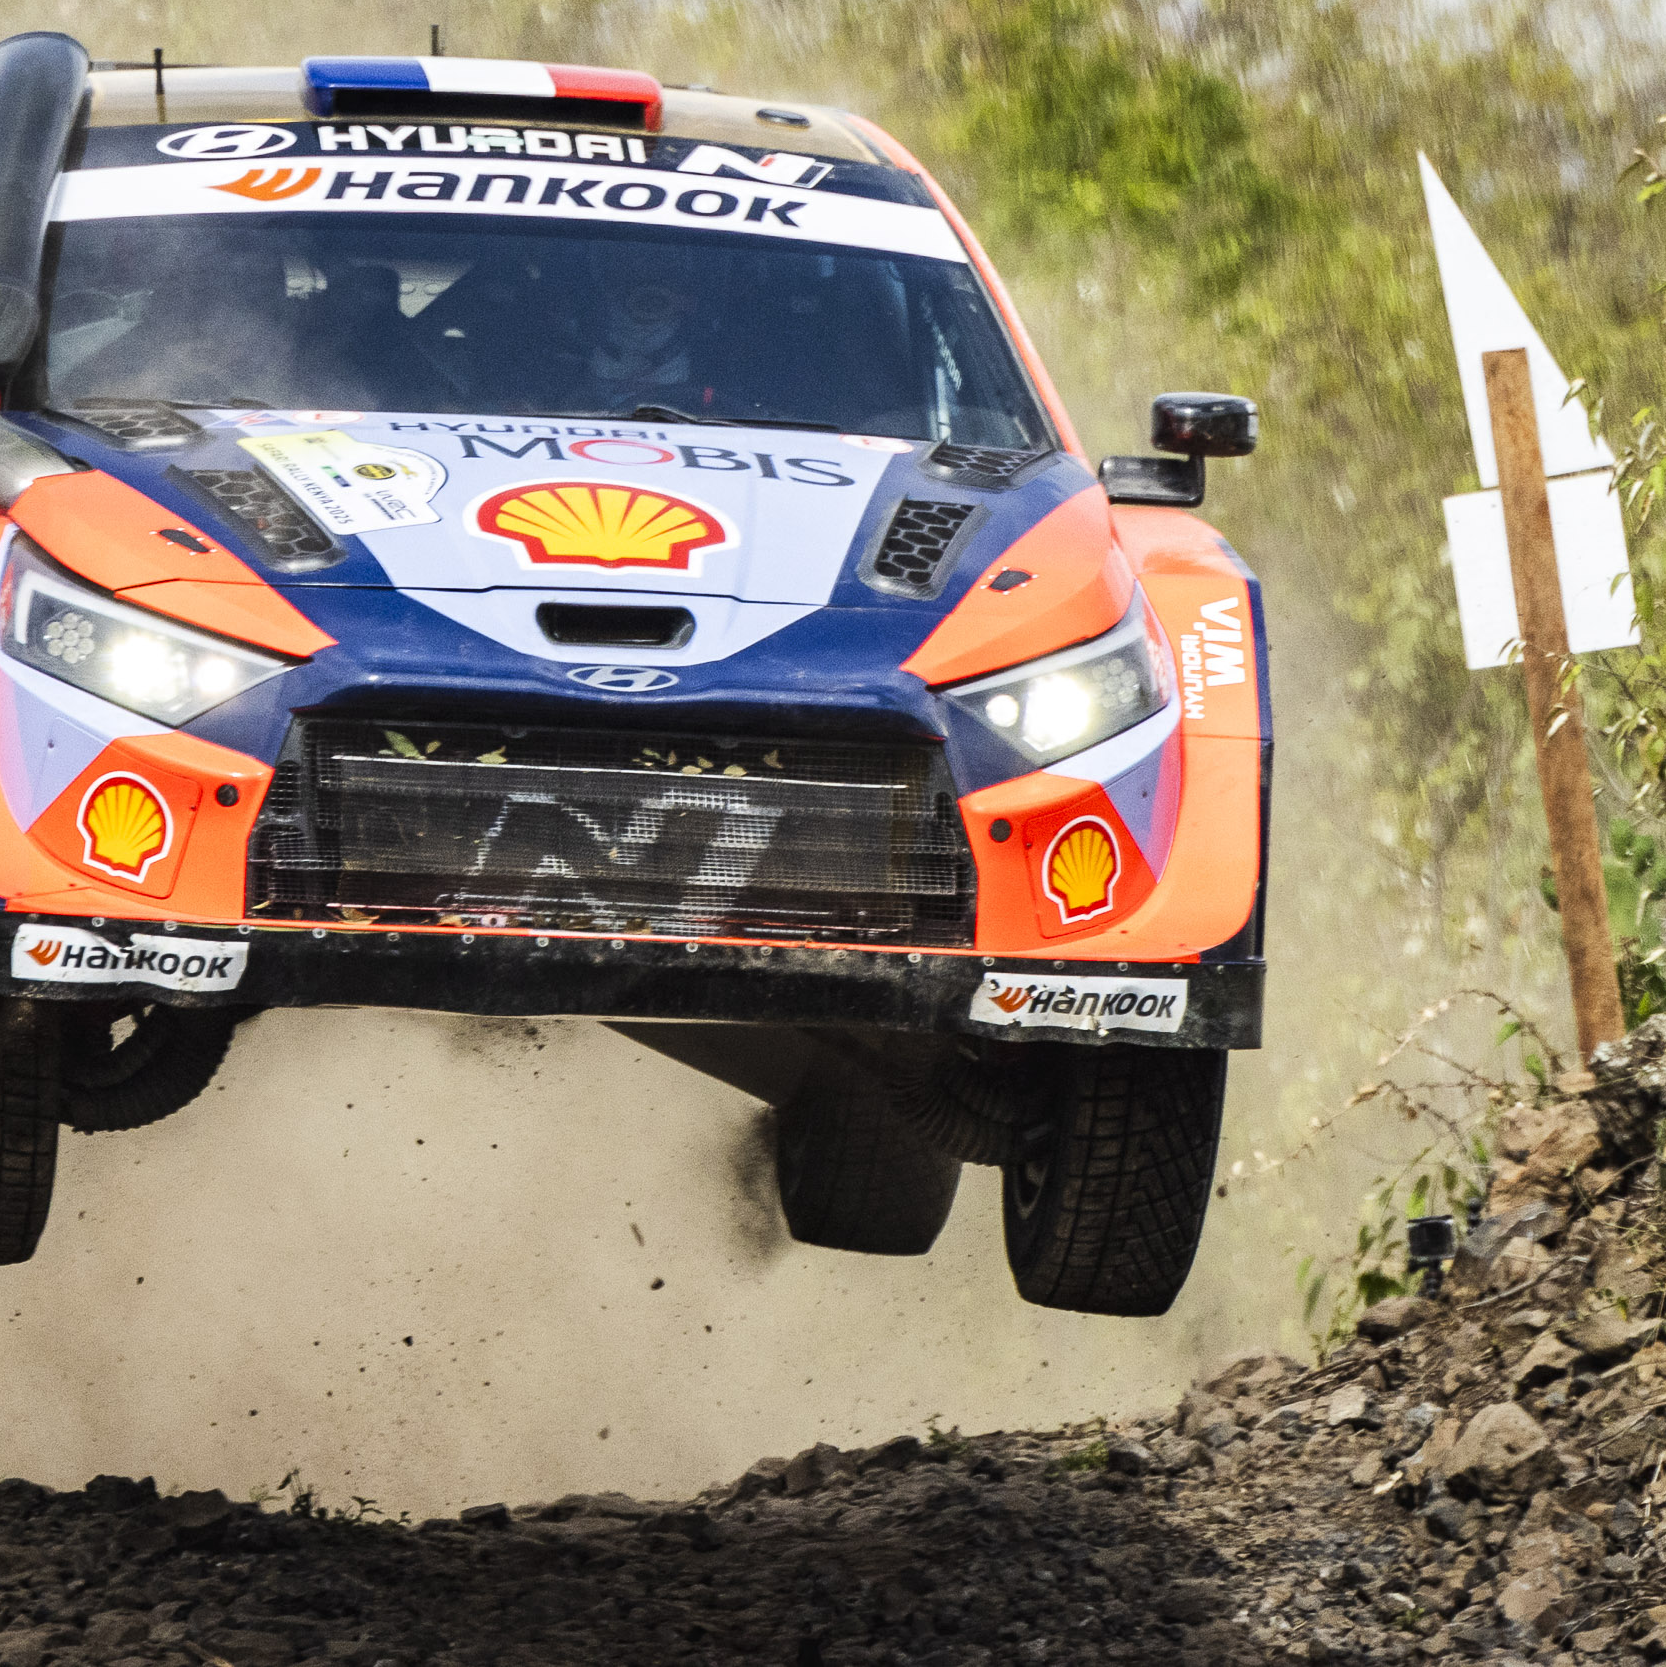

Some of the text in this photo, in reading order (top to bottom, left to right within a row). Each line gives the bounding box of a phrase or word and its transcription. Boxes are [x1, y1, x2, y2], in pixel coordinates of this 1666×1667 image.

[317, 125, 648, 163] HYUNDAI
[388, 421, 668, 441] HYUNDAI
[258, 442, 291, 462] SAFARI
[280, 462, 311, 480] RALLY
[300, 481, 336, 504] KENYA
[323, 504, 357, 524] 2025
[454, 434, 857, 487] MOBIS
[1180, 634, 1205, 720] HYUNDAI
